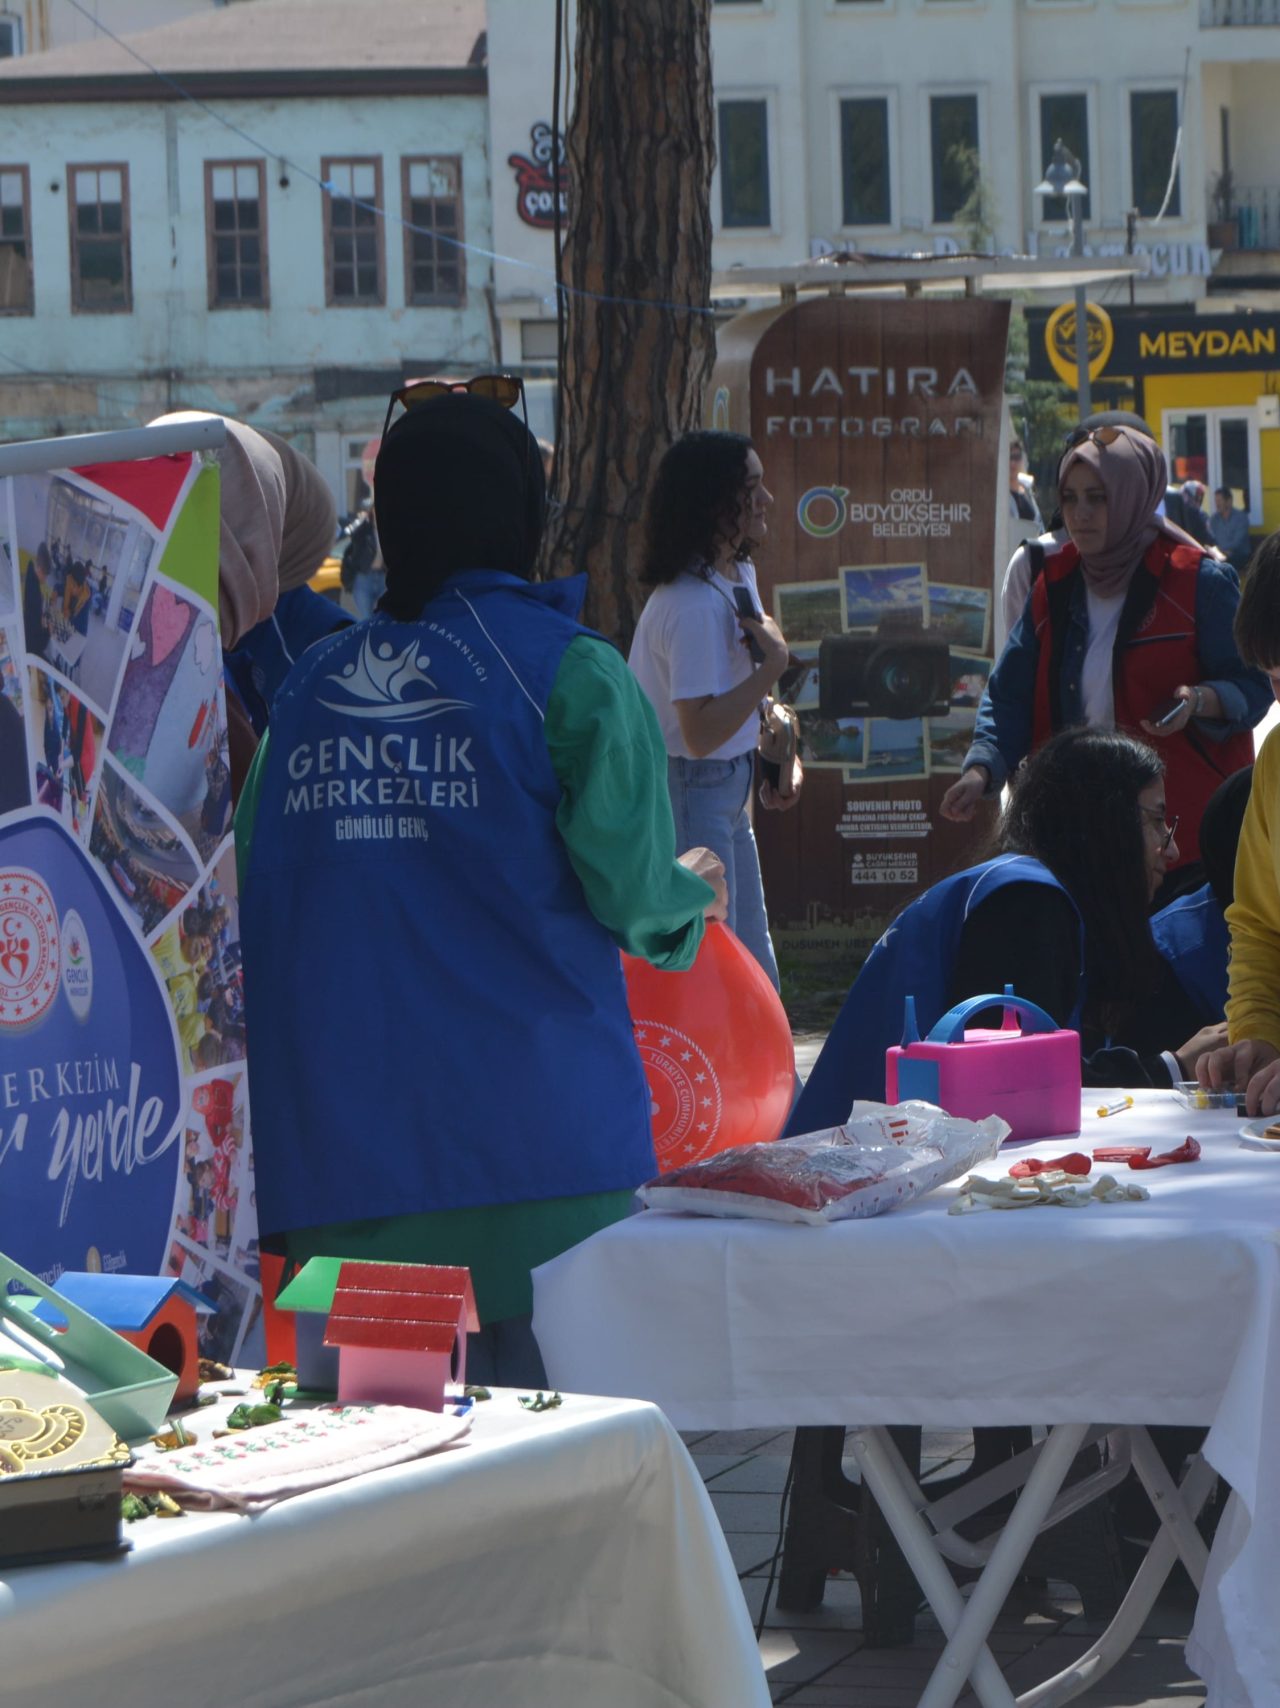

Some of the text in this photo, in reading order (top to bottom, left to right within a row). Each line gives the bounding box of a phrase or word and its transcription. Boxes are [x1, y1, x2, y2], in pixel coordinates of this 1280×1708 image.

[1139, 329, 1275, 359] MEYDAN
[766, 367, 977, 396] HATIRA
[890, 488, 932, 501] ORDU
[851, 501, 971, 525] BÜYÜKŞEHİR
[872, 521, 951, 537] BELEDİYESİ
[287, 733, 476, 781] GENÇLİK
[284, 777, 479, 815] MERKEZLERİ
[847, 800, 922, 812] SOUVENIR PHOTO
[335, 815, 429, 842] GÖNÜLLÜ GENÇ
[855, 870, 915, 881] 444 10 52
[0, 1053, 120, 1108] ERKEZİM
[650, 1053, 687, 1088] TÜRKİYE
[48, 1061, 183, 1229] yerde
